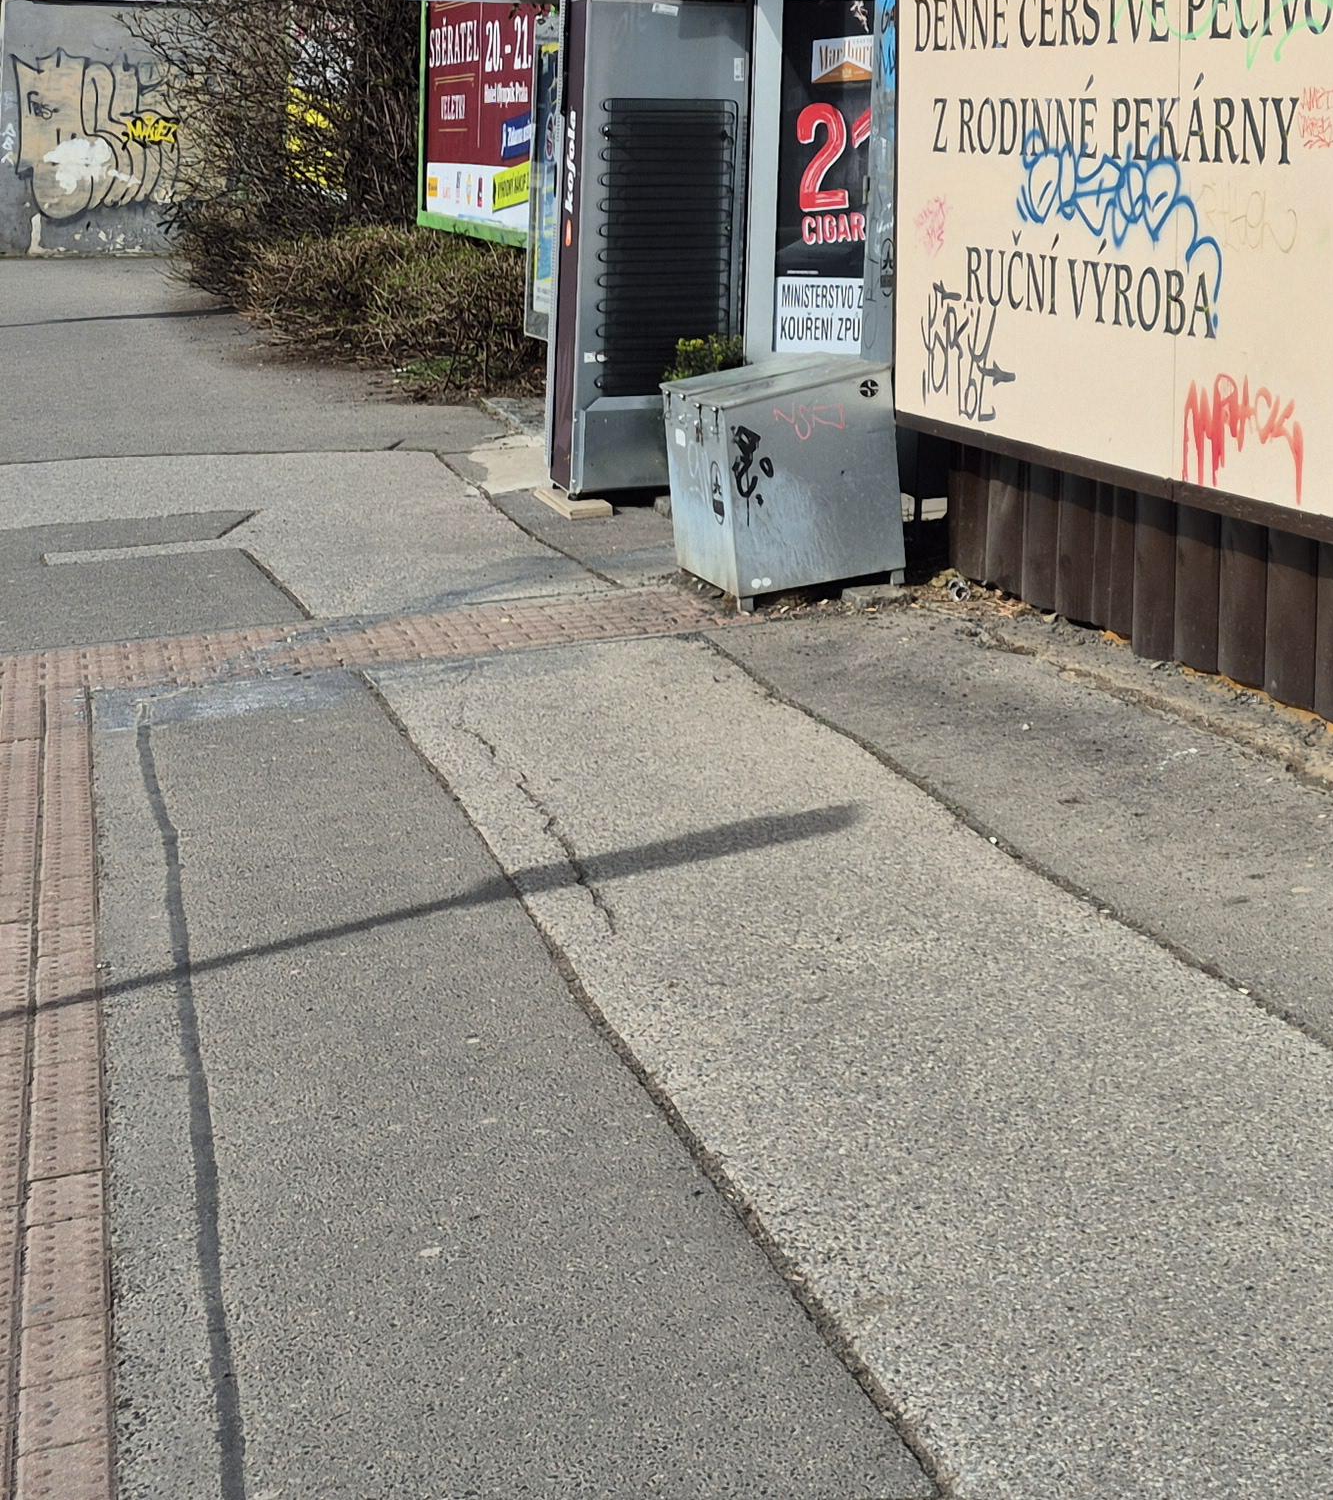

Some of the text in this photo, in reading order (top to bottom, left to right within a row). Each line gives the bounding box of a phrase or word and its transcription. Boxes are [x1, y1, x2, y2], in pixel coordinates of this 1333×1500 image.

[428, 16, 480, 68] SBĚRATEL
[484, 19, 503, 73] 20.
[513, 14, 532, 70] 21.
[932, 97, 948, 152] Z
[958, 74, 1099, 159] RODINNÉ
[1111, 73, 1300, 165] PEKÁRNY
[564, 110, 577, 215] kofola
[781, 284, 854, 310] MINISTERSTVO
[965, 230, 1216, 339] RUČNÍ VÝROBA
[780, 312, 834, 342] KOUŘENÍ
